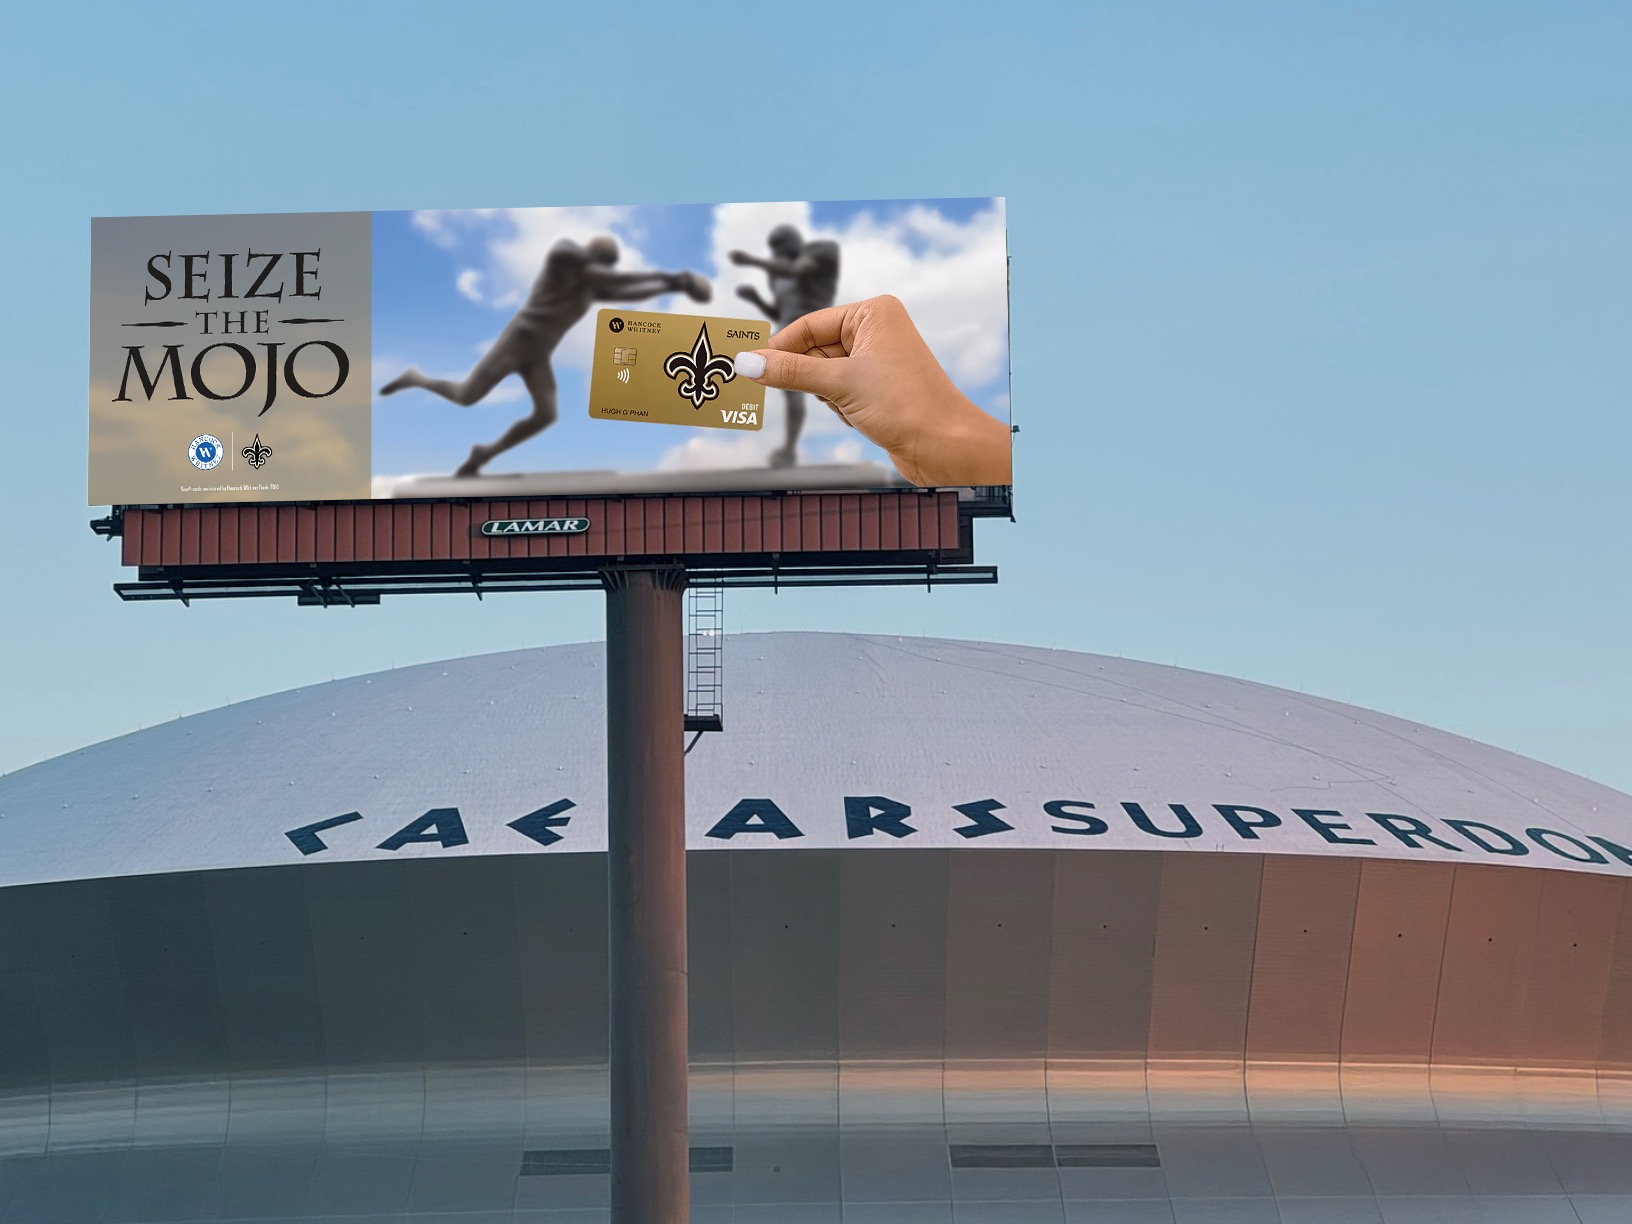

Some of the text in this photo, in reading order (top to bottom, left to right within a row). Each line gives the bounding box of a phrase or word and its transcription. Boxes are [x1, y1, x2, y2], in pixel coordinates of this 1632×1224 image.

[145, 248, 322, 306] SEIZE
[195, 309, 270, 335] THE
[627, 320, 662, 329] HANCOCK
[627, 326, 661, 334] WHITNEY
[726, 329, 760, 340] SAINTS
[112, 341, 349, 417] MOJO
[601, 407, 622, 415] HUGH
[629, 409, 649, 417] PHAN
[741, 403, 759, 411] DEBIT
[720, 409, 757, 425] VISA
[490, 520, 579, 532] LAMAR
[285, 796, 1015, 851] CAEARS
